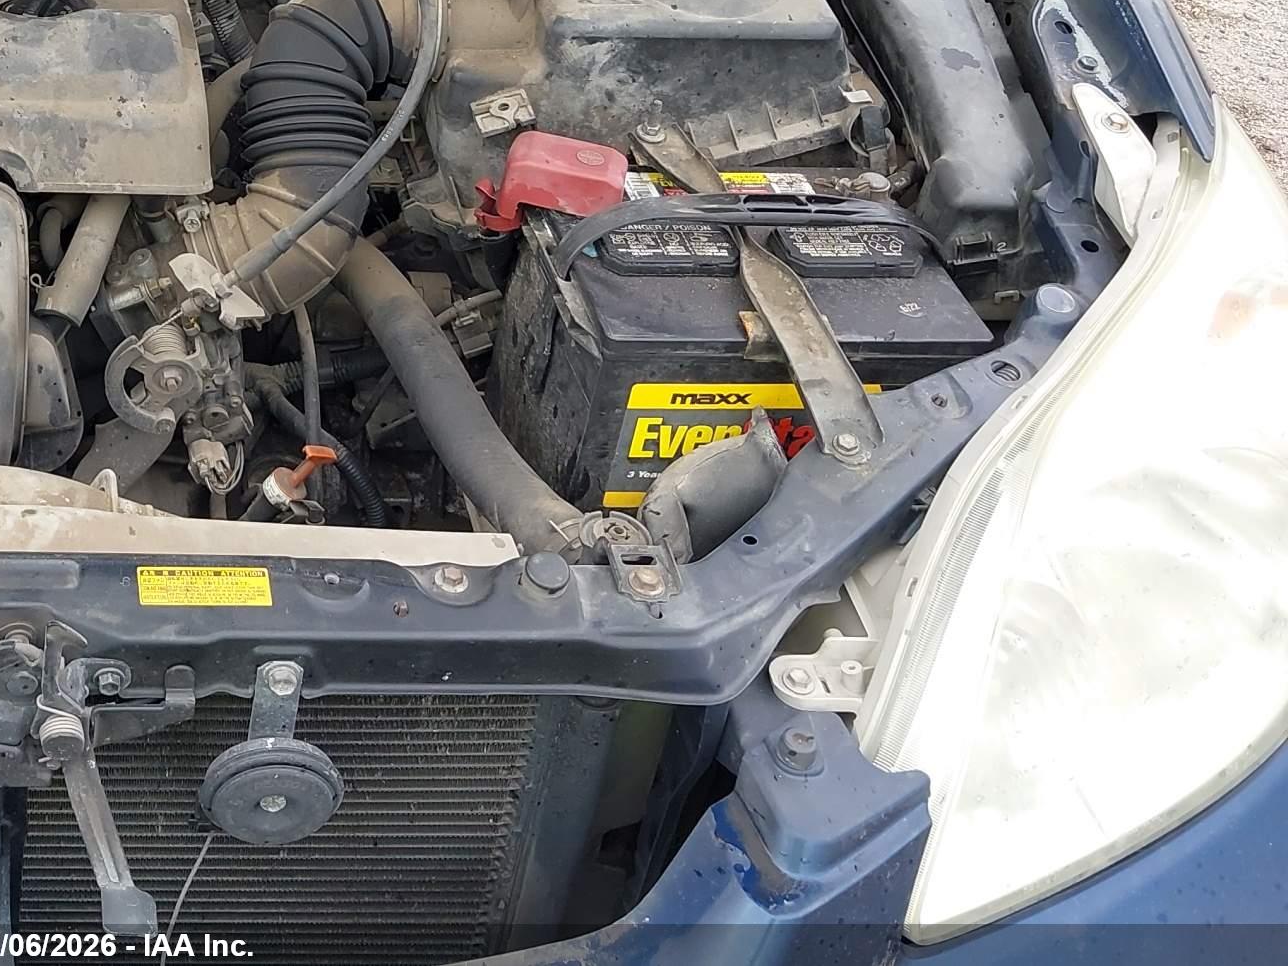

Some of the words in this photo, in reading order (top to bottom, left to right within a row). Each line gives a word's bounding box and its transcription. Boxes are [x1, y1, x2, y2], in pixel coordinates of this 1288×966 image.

[670, 392, 753, 405] maxx
[626, 470, 635, 478] 3
[638, 470, 661, 478] Yea
